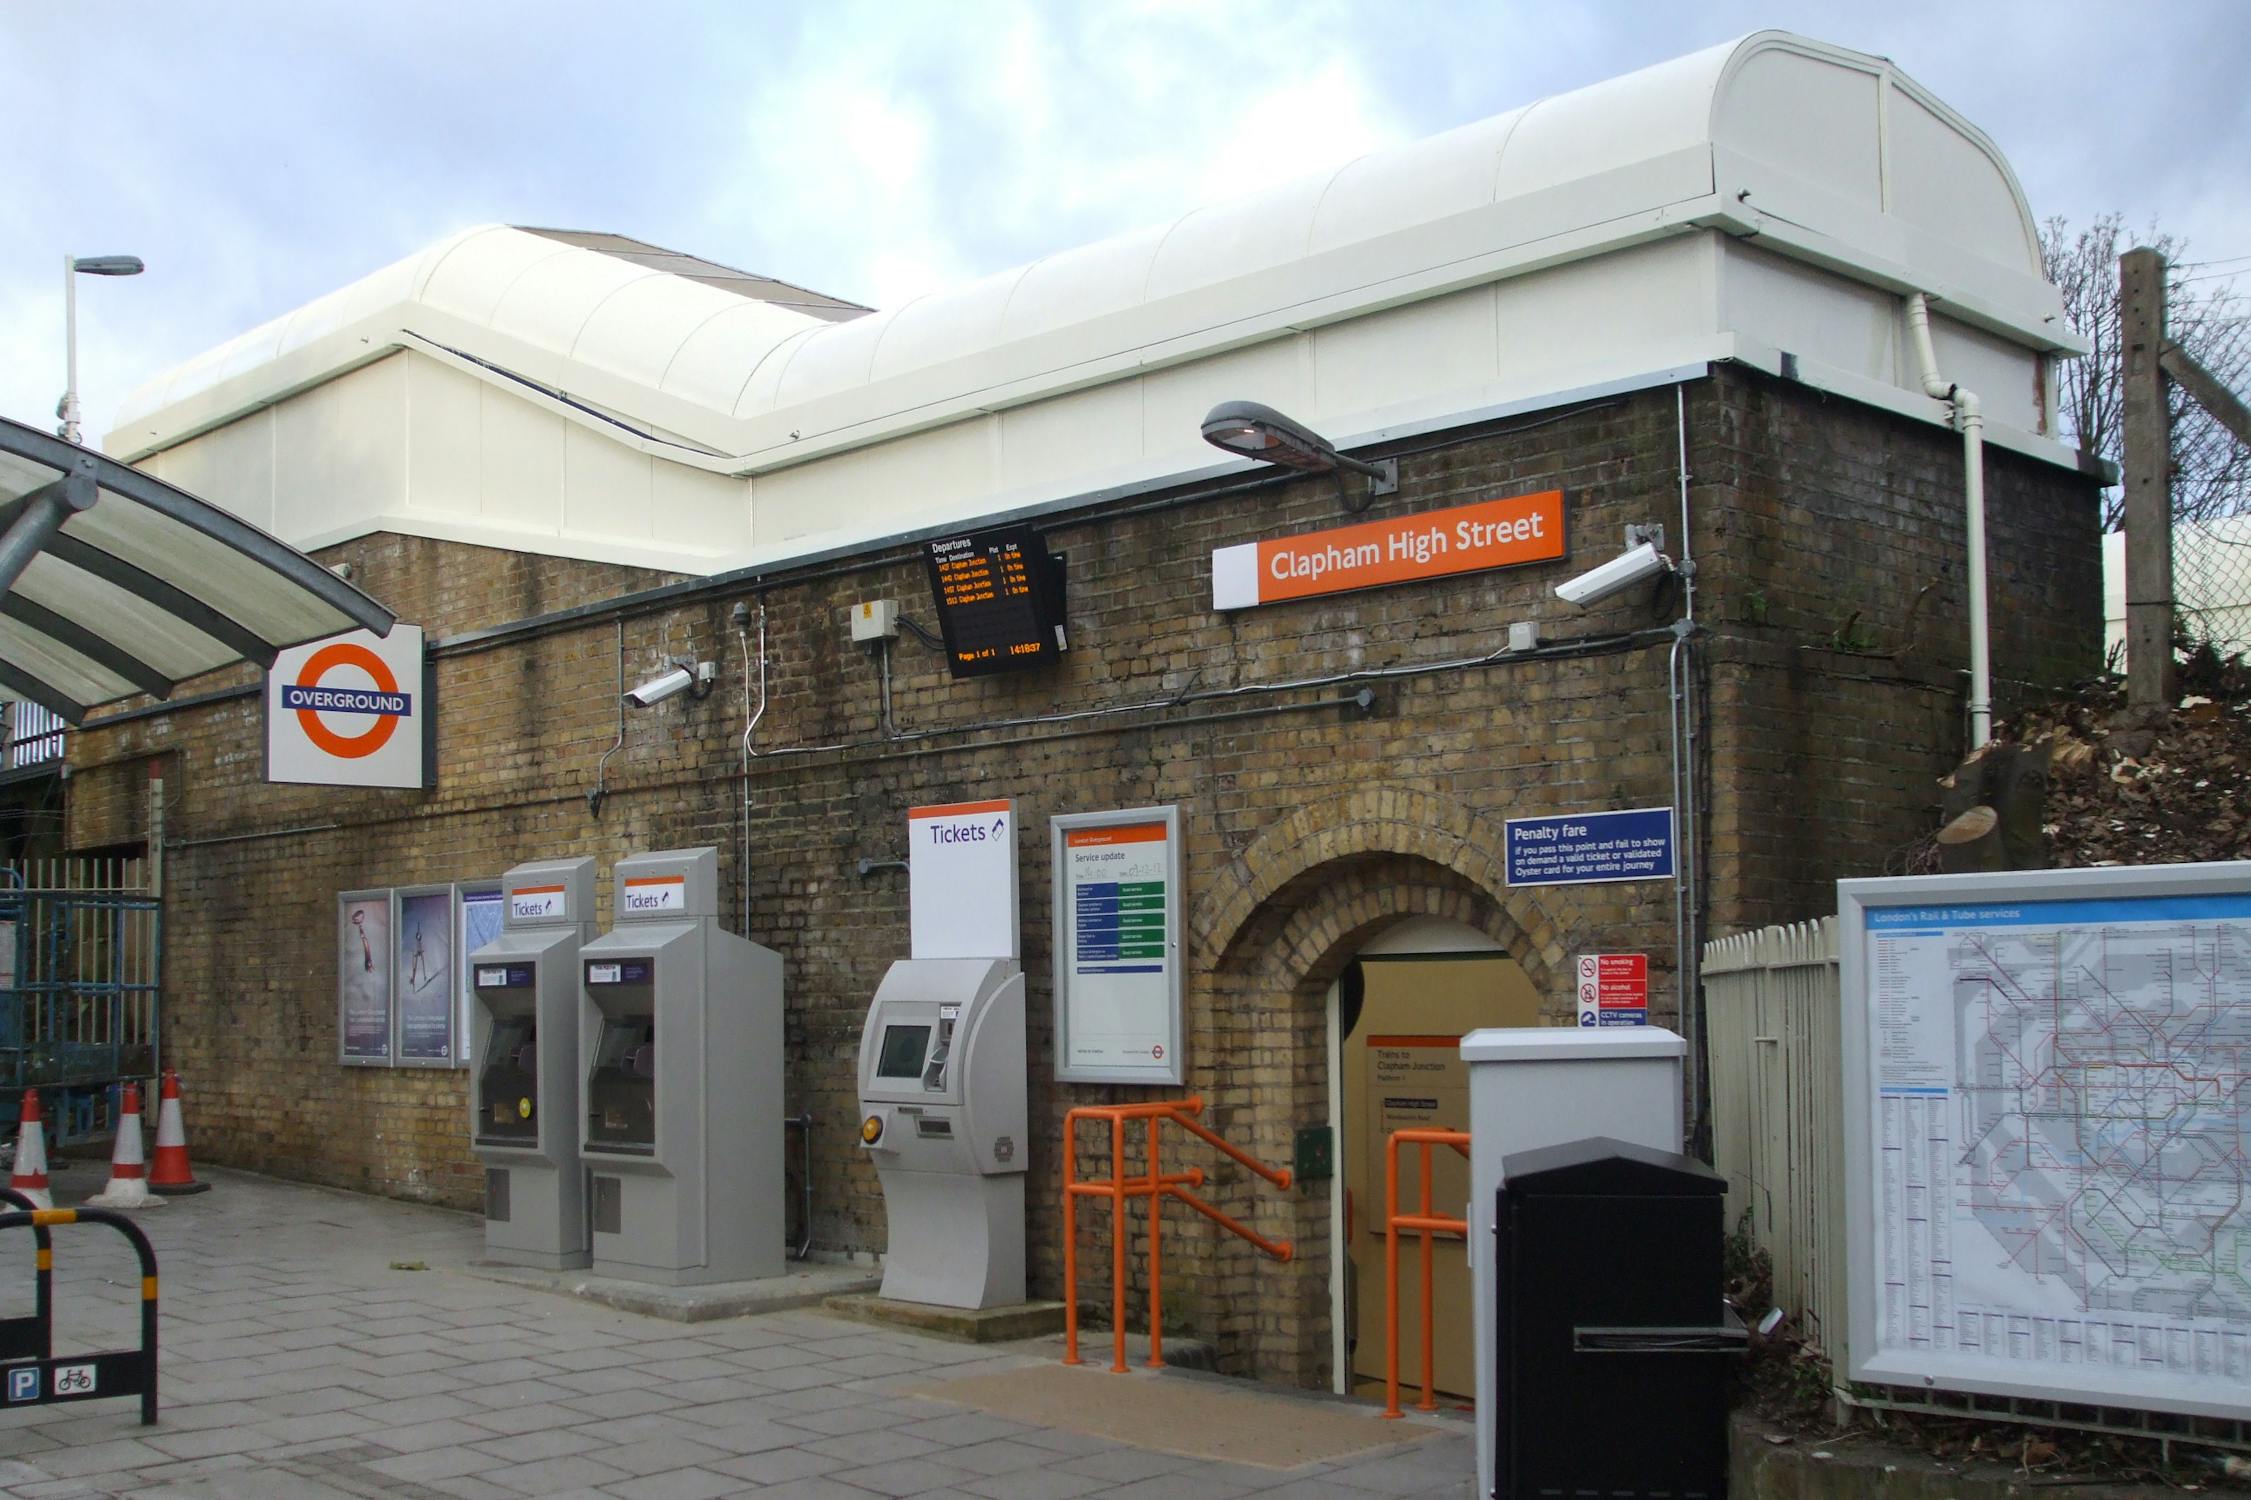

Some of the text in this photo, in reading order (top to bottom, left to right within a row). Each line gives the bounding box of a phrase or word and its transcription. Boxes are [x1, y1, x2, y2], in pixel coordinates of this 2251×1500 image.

[932, 538, 972, 554] Departures
[1270, 511, 1544, 580] Clapham High Street
[949, 552, 975, 561] Destination
[959, 653, 974, 661] Page
[290, 690, 404, 711] OVERGROUND
[930, 822, 986, 844] Tickets
[1514, 824, 1587, 841] Penalty fare
[1515, 846, 1522, 855] If
[1523, 847, 1537, 856] you
[1539, 846, 1556, 855] pass
[1558, 844, 1574, 852] this
[1575, 842, 1596, 852] point
[1598, 841, 1613, 850] and
[1615, 839, 1629, 848] fail
[1643, 838, 1666, 847] show
[1075, 851, 1125, 862] Service update
[1527, 855, 1557, 865] demand
[1565, 853, 1585, 862] valid
[1586, 852, 1610, 861] ticket
[1624, 849, 1662, 858] validated
[1515, 861, 1654, 877] Oyster card for your entire journey
[626, 893, 658, 908] Tickets
[514, 902, 542, 916] Tickets
[1874, 909, 2020, 922] London's Rail & Tube services
[1377, 1050, 1399, 1058] Trains
[1377, 1061, 1446, 1071] Clapham Junction
[16, 1372, 34, 1397] P
